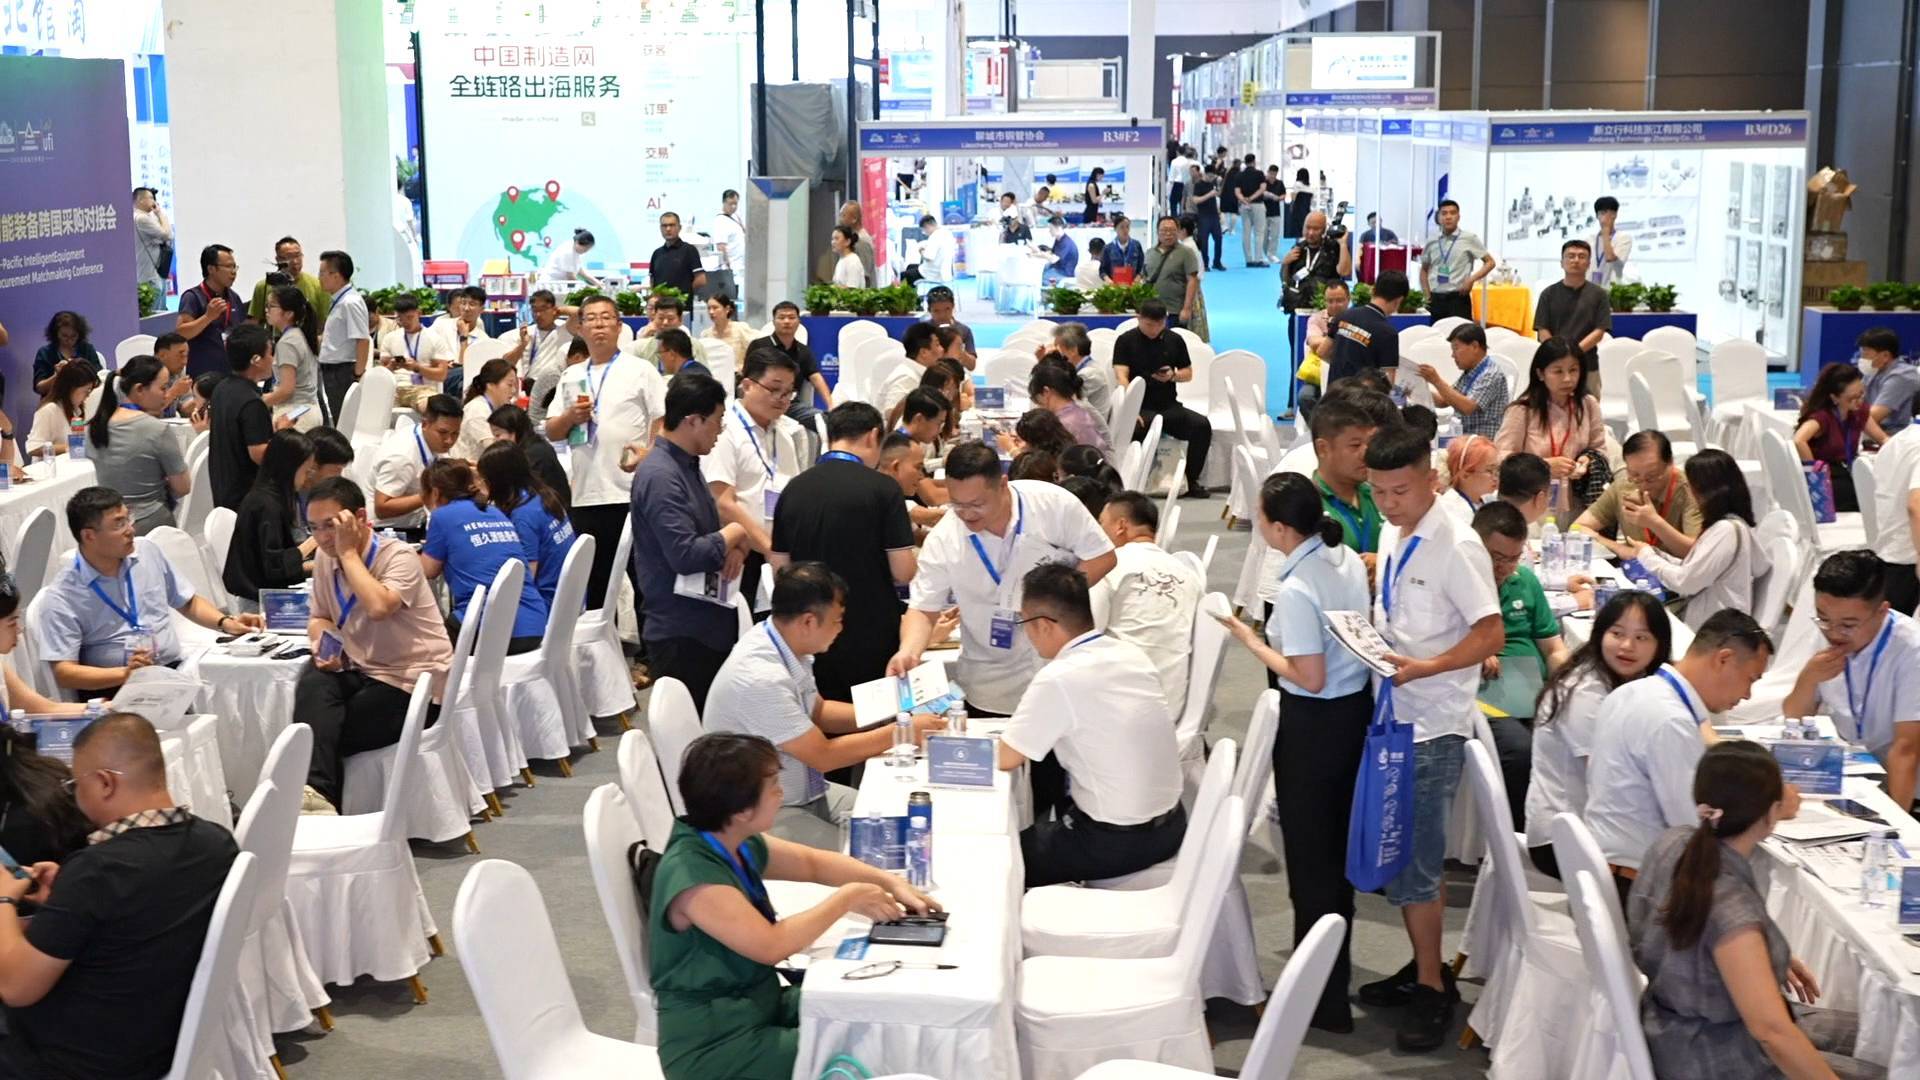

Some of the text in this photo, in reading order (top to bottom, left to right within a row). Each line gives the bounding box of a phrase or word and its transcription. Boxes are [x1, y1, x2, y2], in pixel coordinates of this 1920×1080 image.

[473, 45, 595, 68] 中国制造网
[449, 74, 621, 99] 全链路出海服务
[1103, 131, 1140, 142] B3#F2
[1744, 123, 1792, 136] B3#D26
[0, 204, 117, 243] 能装备跨国采购对接会
[73, 263, 104, 277] Conference
